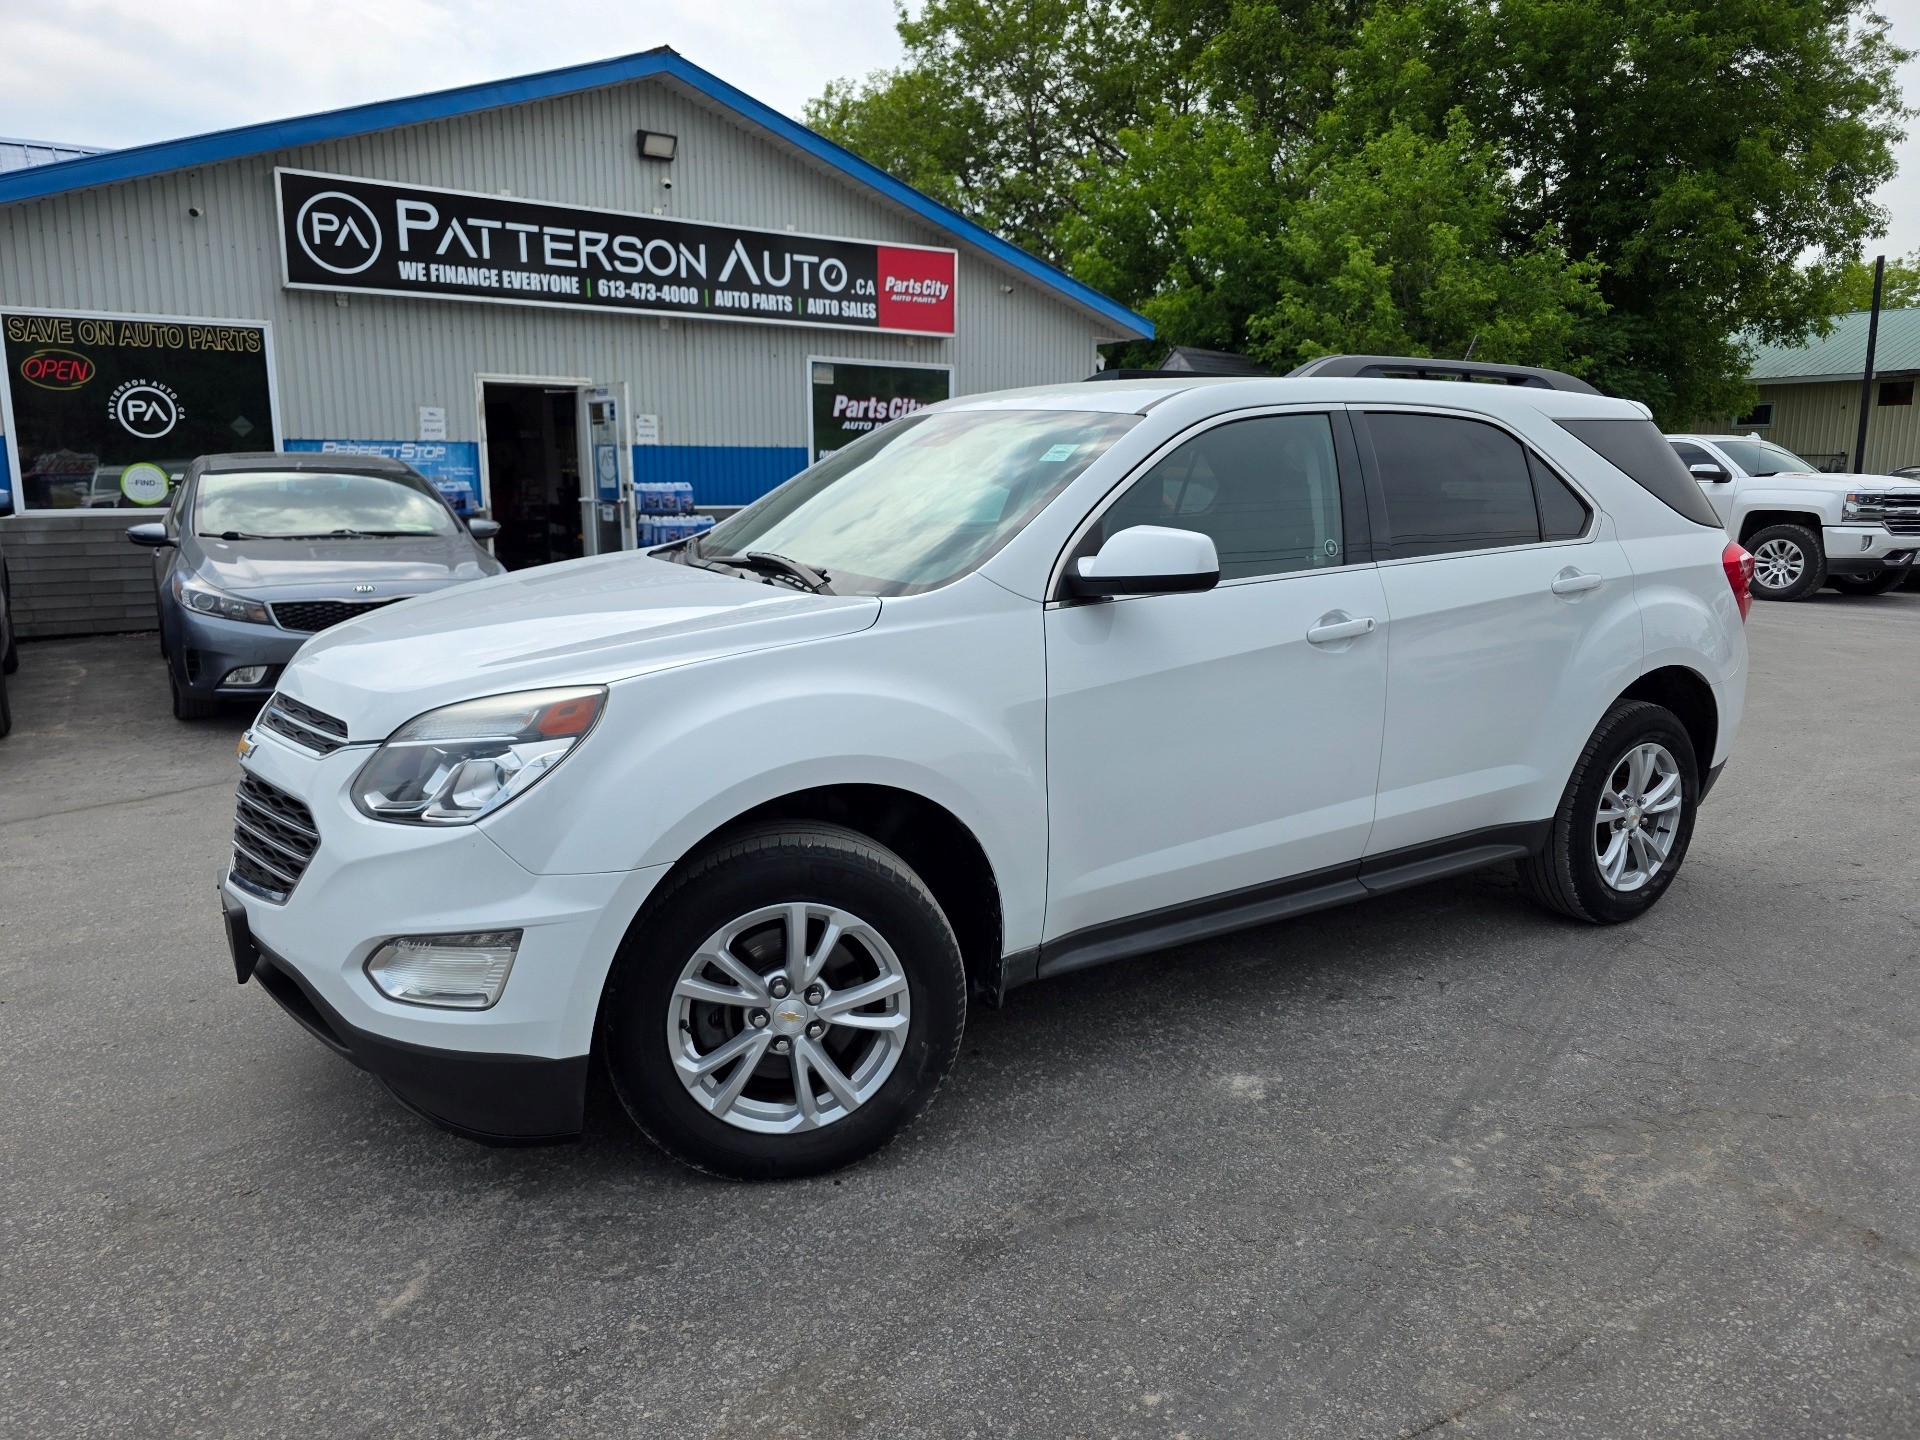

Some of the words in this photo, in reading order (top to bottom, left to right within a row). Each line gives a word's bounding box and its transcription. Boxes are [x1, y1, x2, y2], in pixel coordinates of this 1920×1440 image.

[311, 211, 370, 249] PA
[395, 198, 707, 280] PATTERSON
[718, 238, 848, 293] AUTO
[398, 260, 427, 282] WE
[429, 263, 499, 288] FINANCE
[502, 269, 580, 295] EVERYONE
[597, 278, 699, 305] 613-473-4000
[714, 289, 749, 310] AUTO
[751, 293, 793, 313] PARTS
[807, 298, 841, 318] AUTO
[841, 300, 877, 319] SALES
[891, 294, 911, 302] AUTO
[912, 296, 937, 304] PARTS
[8, 316, 75, 344] SAVE
[78, 319, 115, 346] ON
[119, 321, 184, 349] AUTO
[188, 325, 262, 352] PARTS
[24, 358, 89, 381] OPEN
[108, 378, 146, 420] PATTERSON
[151, 380, 178, 400] AUTO
[127, 399, 169, 421] PA
[841, 420, 872, 430] AUTO
[135, 479, 156, 487] FIND
